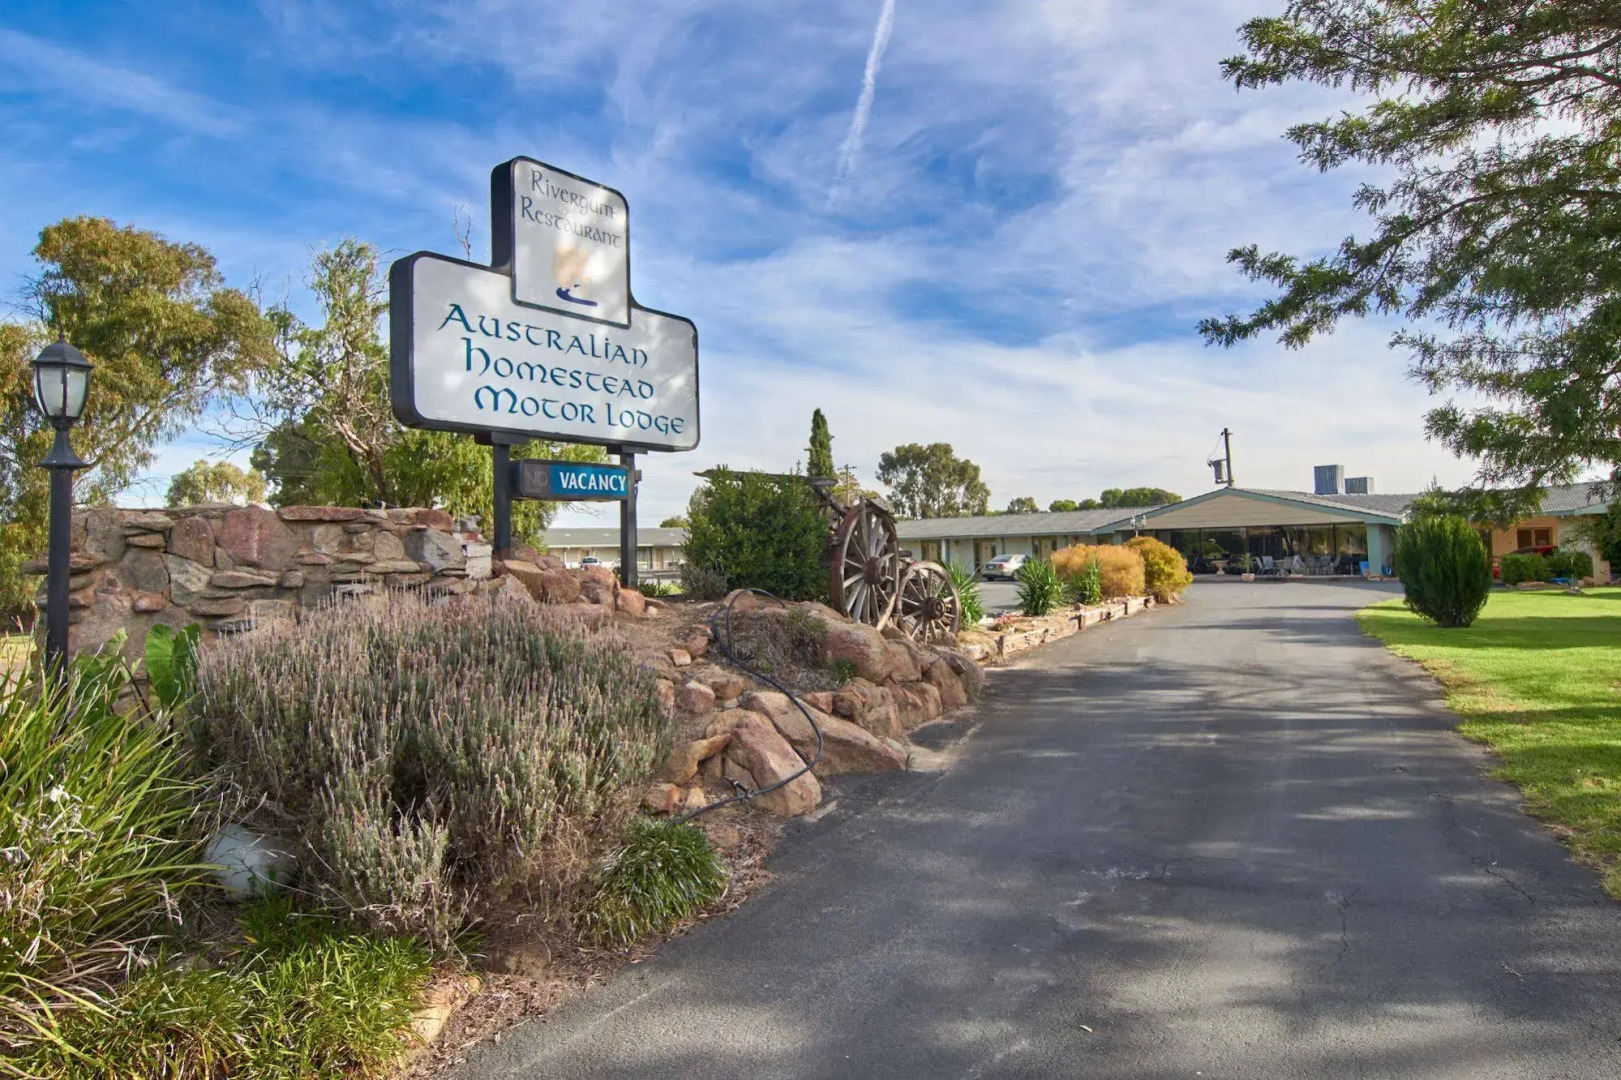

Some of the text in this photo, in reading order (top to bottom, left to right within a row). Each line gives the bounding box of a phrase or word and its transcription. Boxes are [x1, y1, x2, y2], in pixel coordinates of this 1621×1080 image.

[531, 169, 614, 218] Rivergum
[437, 303, 648, 368] AUSTRALIAN
[461, 337, 655, 400] HOMESTEAD
[474, 385, 686, 436] MOTOR LODGE
[559, 471, 627, 492] VACANCY
